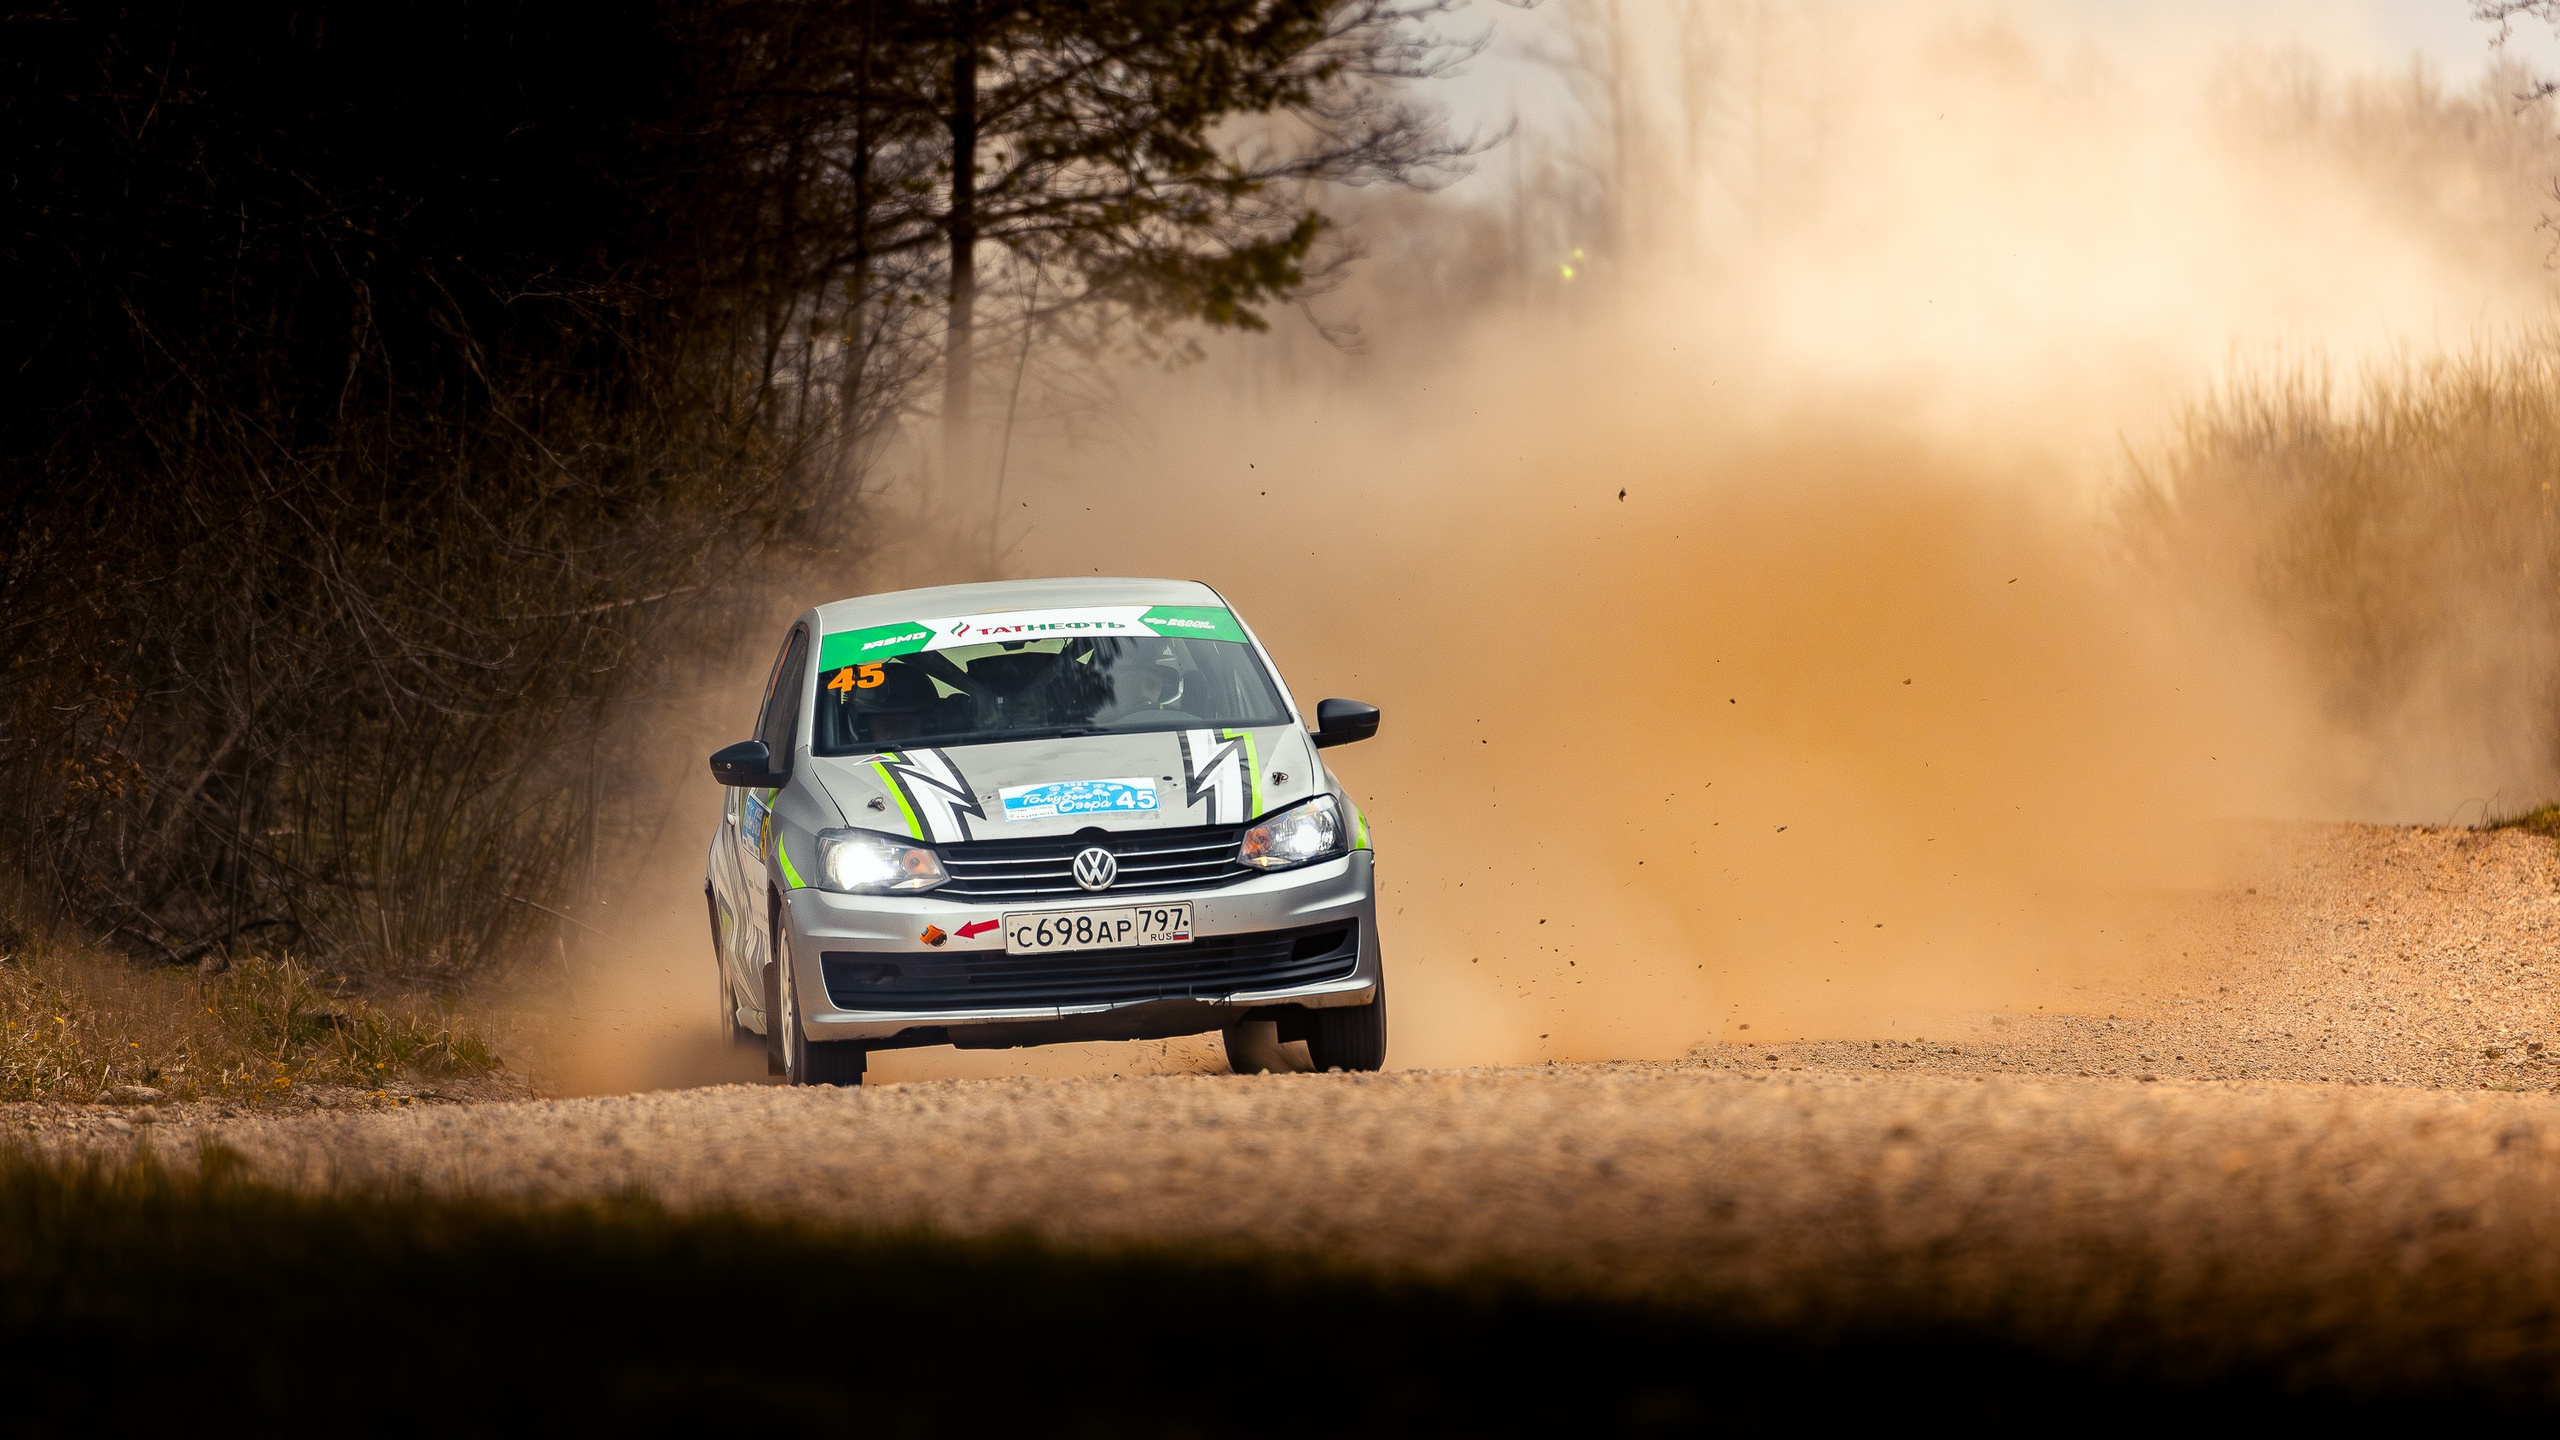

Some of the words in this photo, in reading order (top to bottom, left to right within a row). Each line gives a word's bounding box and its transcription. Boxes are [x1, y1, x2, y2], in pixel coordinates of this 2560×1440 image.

[976, 621, 1126, 636] ТАТНЕФТЬ
[827, 663, 885, 692] 45
[1116, 790, 1156, 809] 45
[1139, 908, 1183, 932] 797
[1150, 933, 1172, 942] RUS
